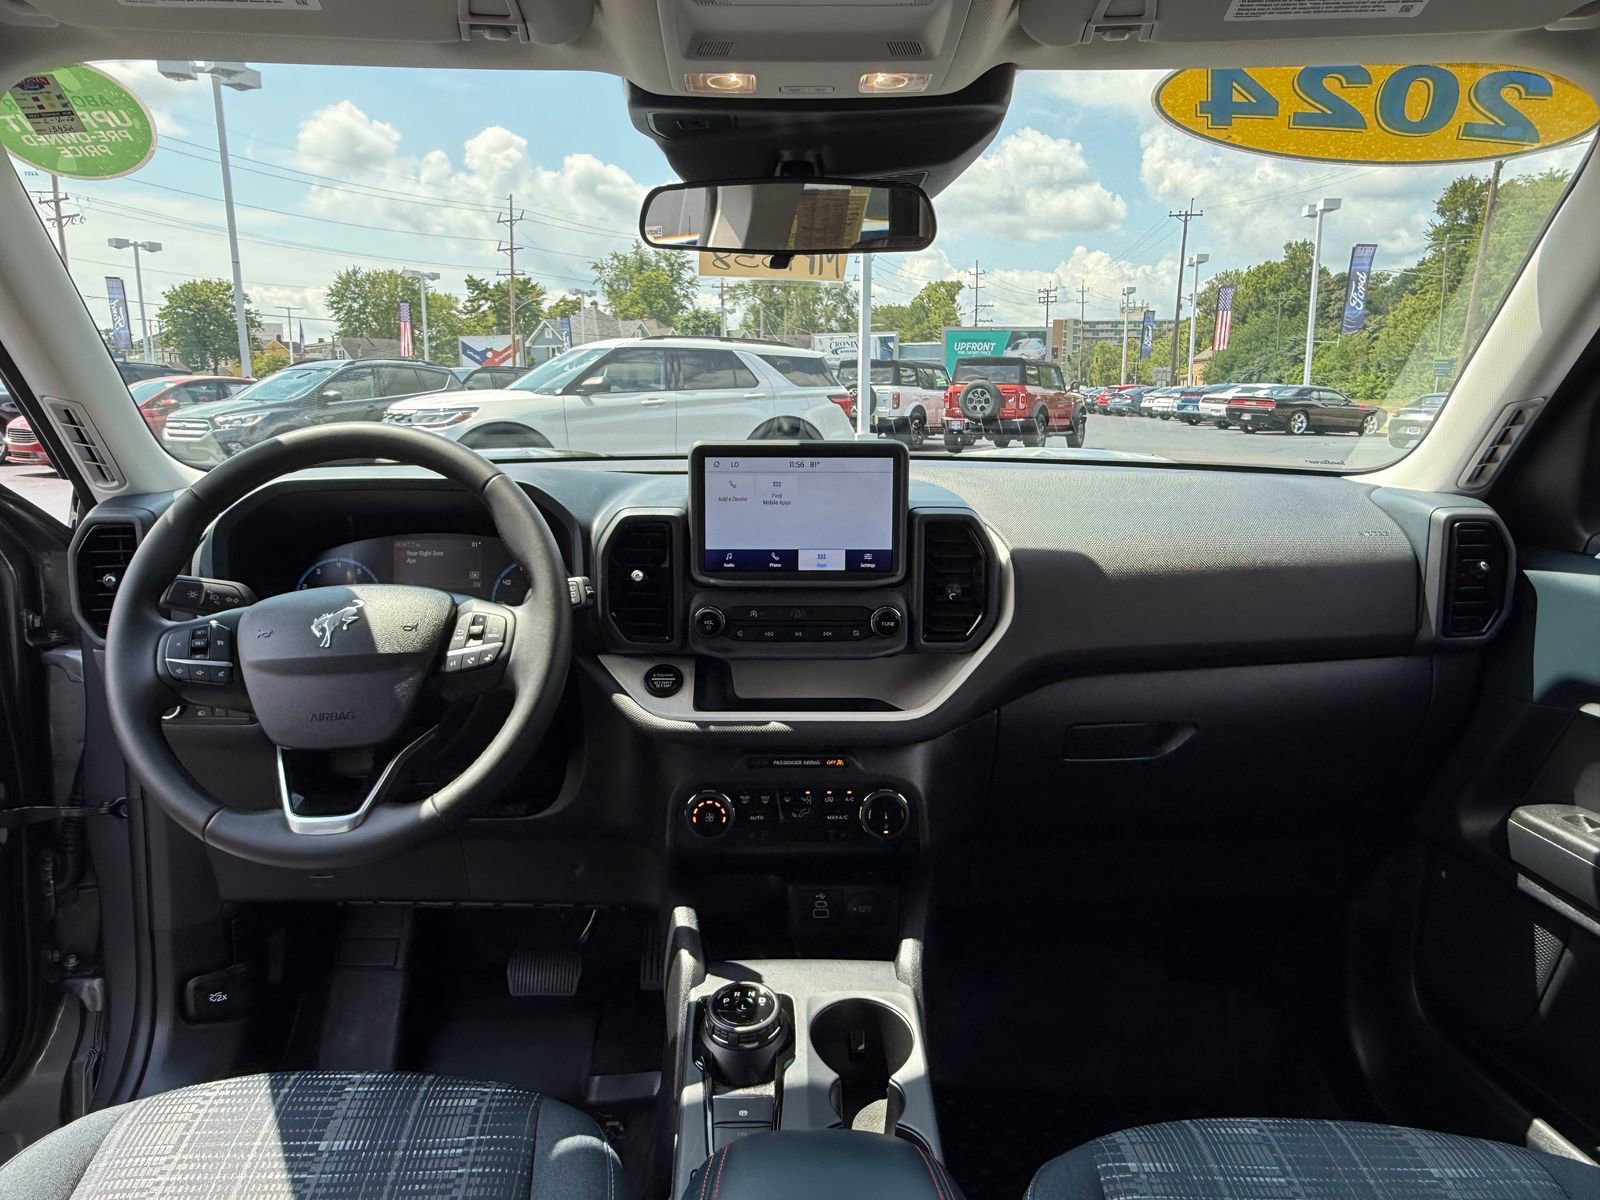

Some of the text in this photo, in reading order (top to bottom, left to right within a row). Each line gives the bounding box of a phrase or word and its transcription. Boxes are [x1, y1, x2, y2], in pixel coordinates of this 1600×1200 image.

[1349, 271, 1367, 310] Ford
[954, 342, 996, 351] UPFRONT
[310, 711, 355, 722] AIRBAG
[758, 996, 767, 1004] D
